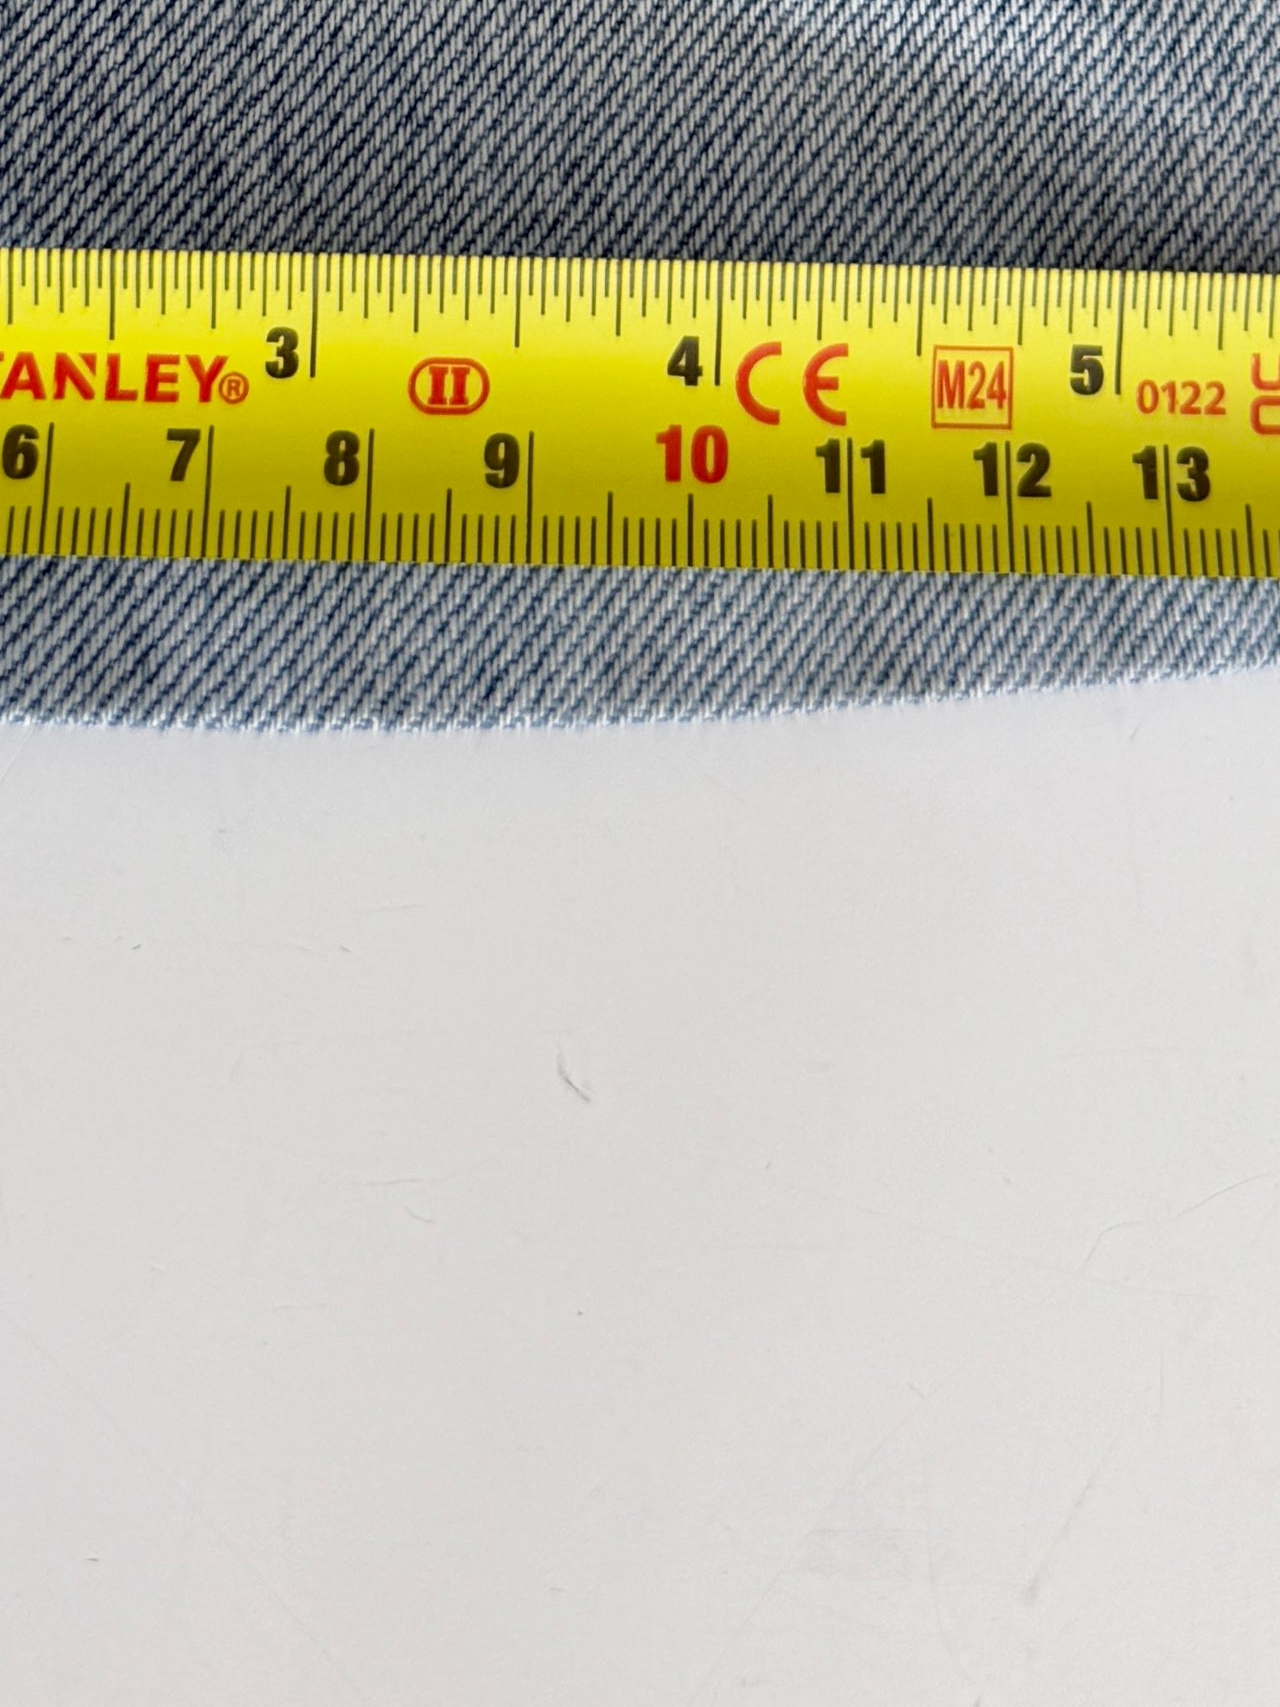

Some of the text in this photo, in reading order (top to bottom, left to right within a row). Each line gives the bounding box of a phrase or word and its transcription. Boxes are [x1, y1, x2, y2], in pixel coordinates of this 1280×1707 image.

[265, 327, 299, 379] 3
[666, 335, 704, 387] 4
[1070, 345, 1104, 397] 5
[735, 341, 849, 427] CE
[936, 360, 1007, 411] M24
[1136, 379, 1227, 416] 0122
[1, 424, 40, 480] 6
[166, 428, 201, 482] 7
[323, 430, 360, 486] 8
[483, 433, 520, 489] 9
[655, 423, 729, 484] 10
[815, 438, 887, 495] 11
[973, 442, 1052, 499] 12
[1131, 445, 1212, 503] 13
